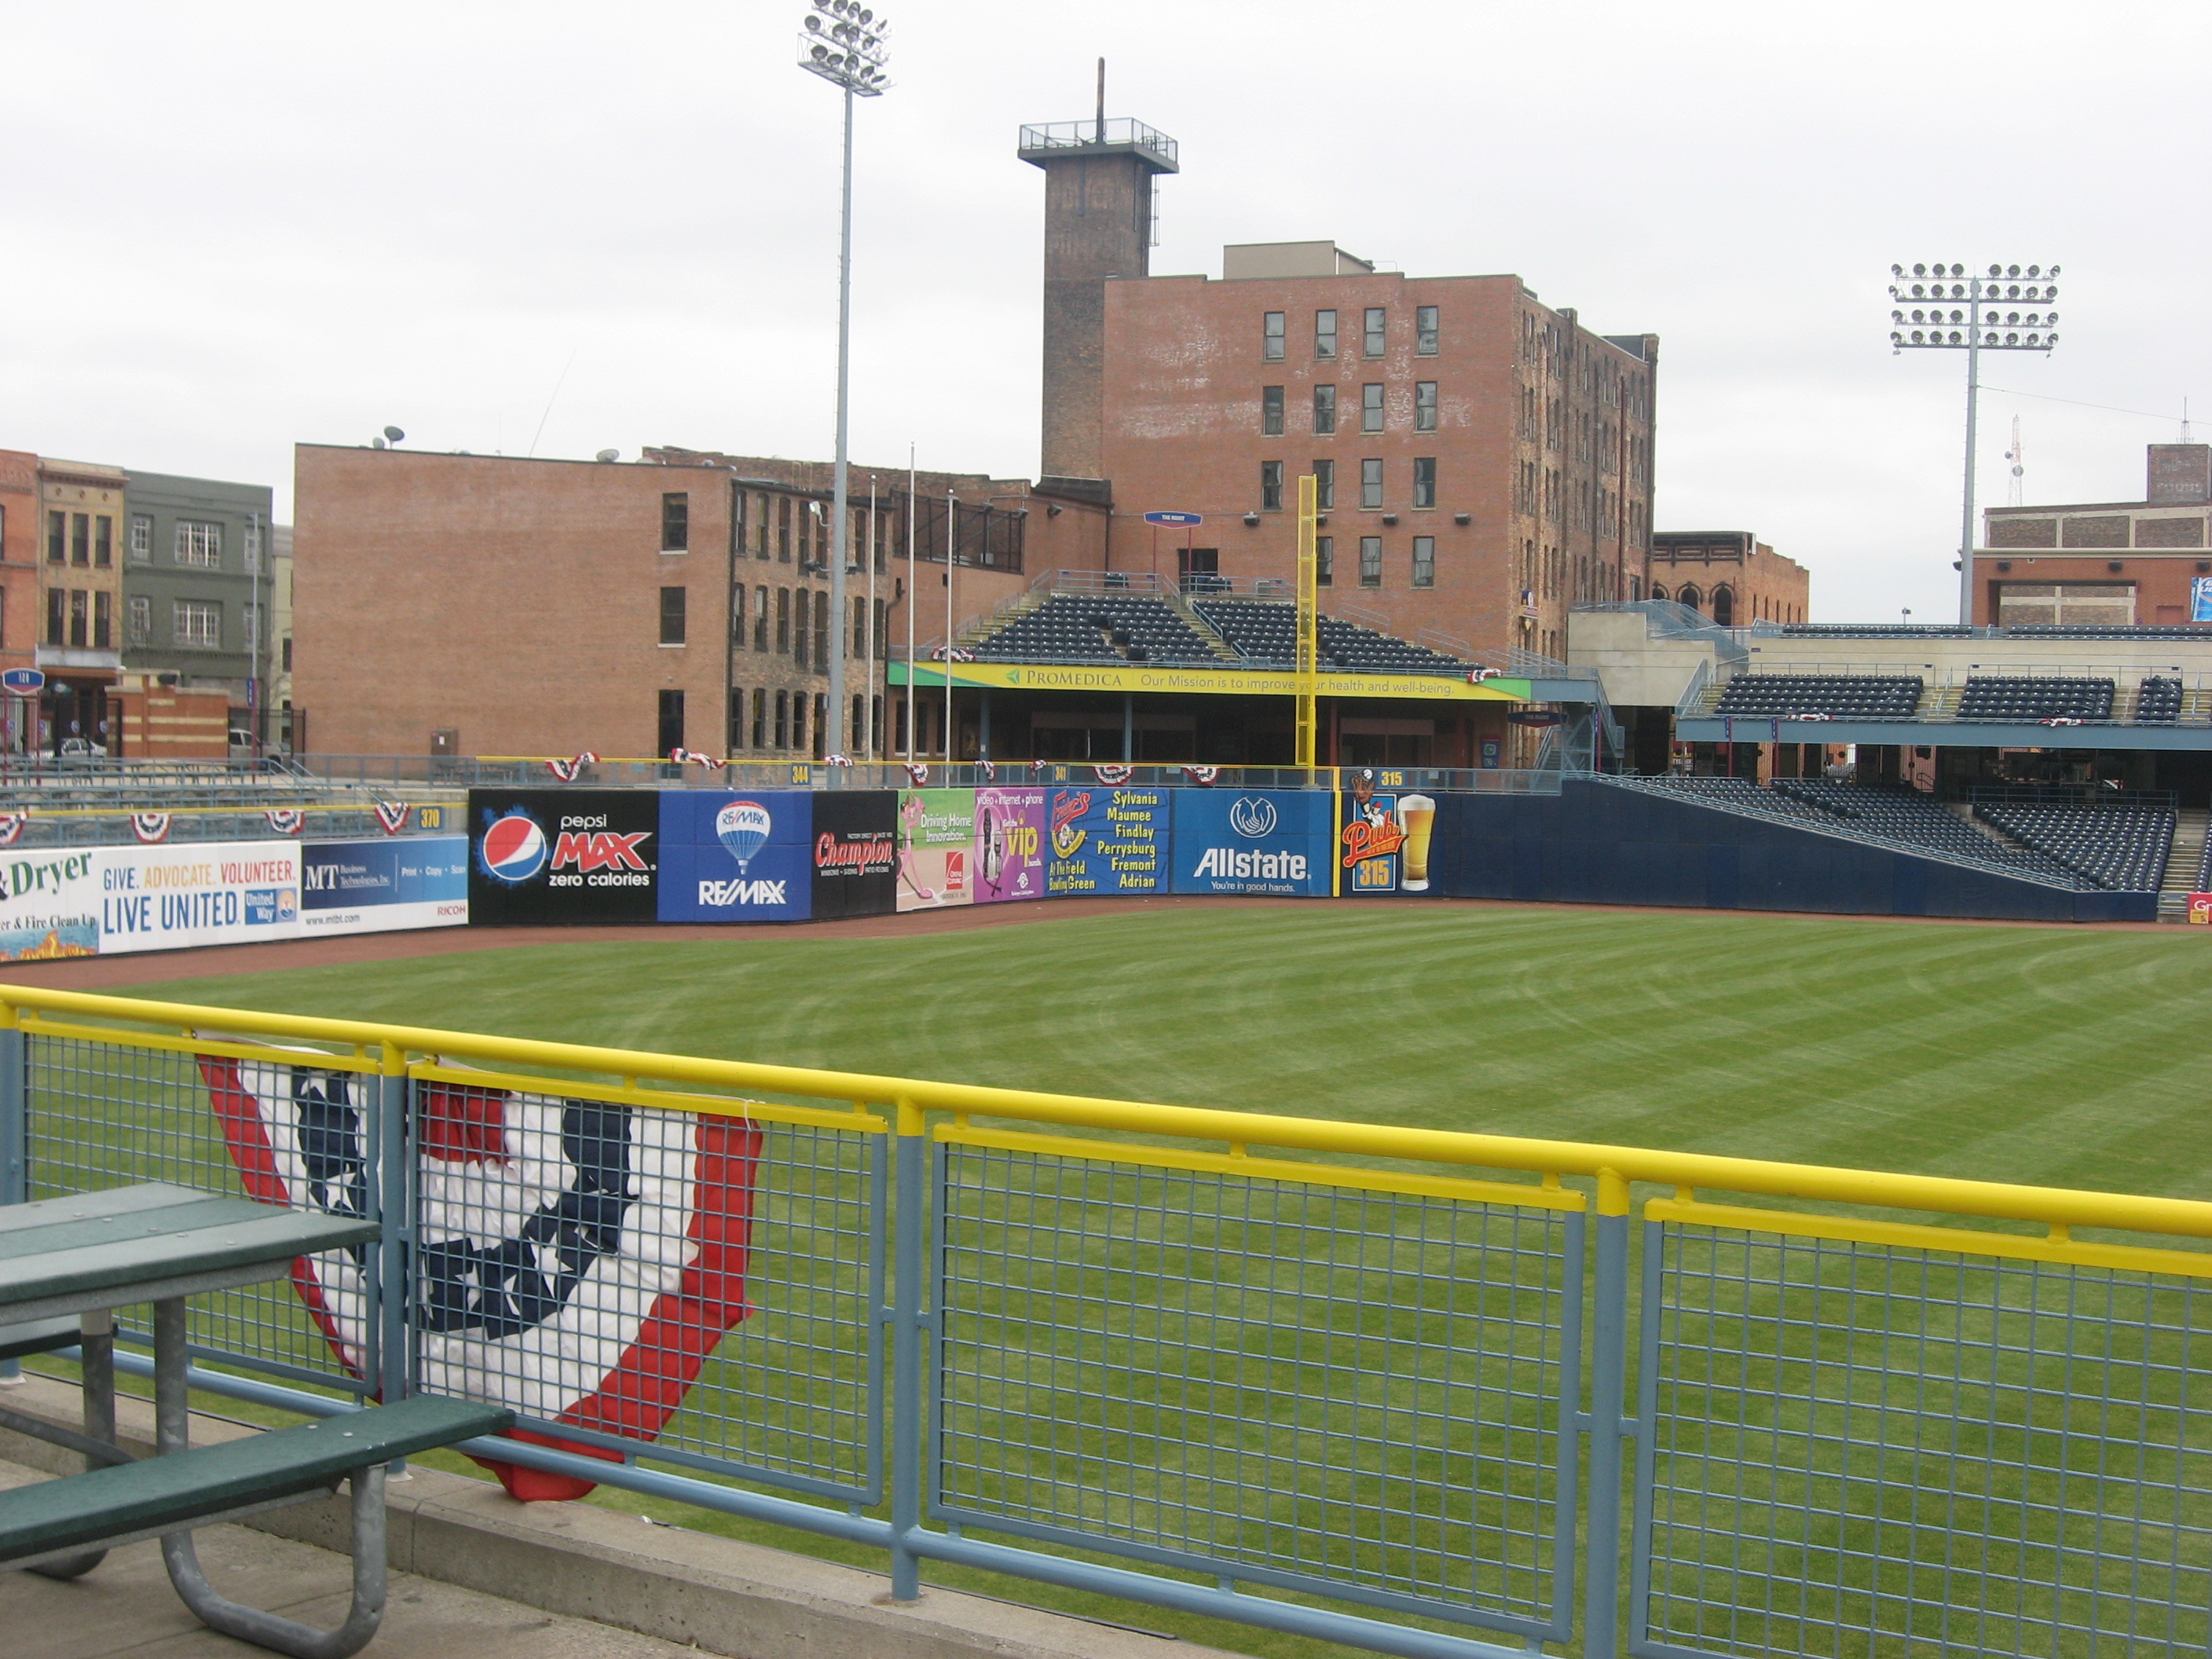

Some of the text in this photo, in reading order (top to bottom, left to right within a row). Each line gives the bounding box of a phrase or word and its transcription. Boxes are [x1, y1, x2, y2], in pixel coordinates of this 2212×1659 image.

[1141, 674, 1164, 687] Our
[1169, 676, 1214, 688] Mission
[1218, 677, 1226, 688] is
[1231, 678, 1242, 689] to
[1247, 679, 1295, 692] improve
[1329, 679, 1365, 691] health
[1368, 680, 1390, 692] and
[1393, 680, 1455, 696] well-being.
[793, 766, 808, 783] 344
[1381, 771, 1403, 786] 315
[977, 793, 1044, 808] video internet phone
[1112, 791, 1159, 808] Sylvania
[421, 808, 441, 828] 370
[560, 814, 606, 830] pepsi
[722, 810, 765, 826] RE/MAX
[921, 813, 972, 830] Driving Home
[1107, 808, 1152, 822] Maumee
[1115, 824, 1155, 842] Findlay
[550, 832, 653, 873] MAX
[815, 833, 892, 876] Champion
[1005, 826, 1038, 867] vip
[1097, 840, 1155, 858] Perrysburg
[401, 865, 466, 877] Print Copy Scan
[1111, 857, 1156, 871] Fremont
[1193, 848, 1307, 880] Allstate
[1359, 859, 1390, 886] 315
[9, 851, 92, 896] Dryer
[104, 860, 295, 891] GIVE. ADVOCATE. VOLUNTEER.
[305, 865, 339, 890] MT
[549, 872, 650, 887] zero calories
[1119, 873, 1155, 888] Adrian
[1068, 875, 1096, 890] Green
[1211, 881, 1236, 890] You're
[1246, 882, 1267, 892] good
[1269, 883, 1295, 892] hands.
[246, 892, 275, 906] United
[698, 878, 786, 906] RE/MAX
[104, 896, 152, 934] LIVE
[256, 906, 274, 923] Way
[438, 906, 466, 916] RICOH
[14, 916, 22, 930] &
[25, 914, 47, 928] Fire
[49, 914, 79, 928] Clean
[82, 913, 96, 928] Up
